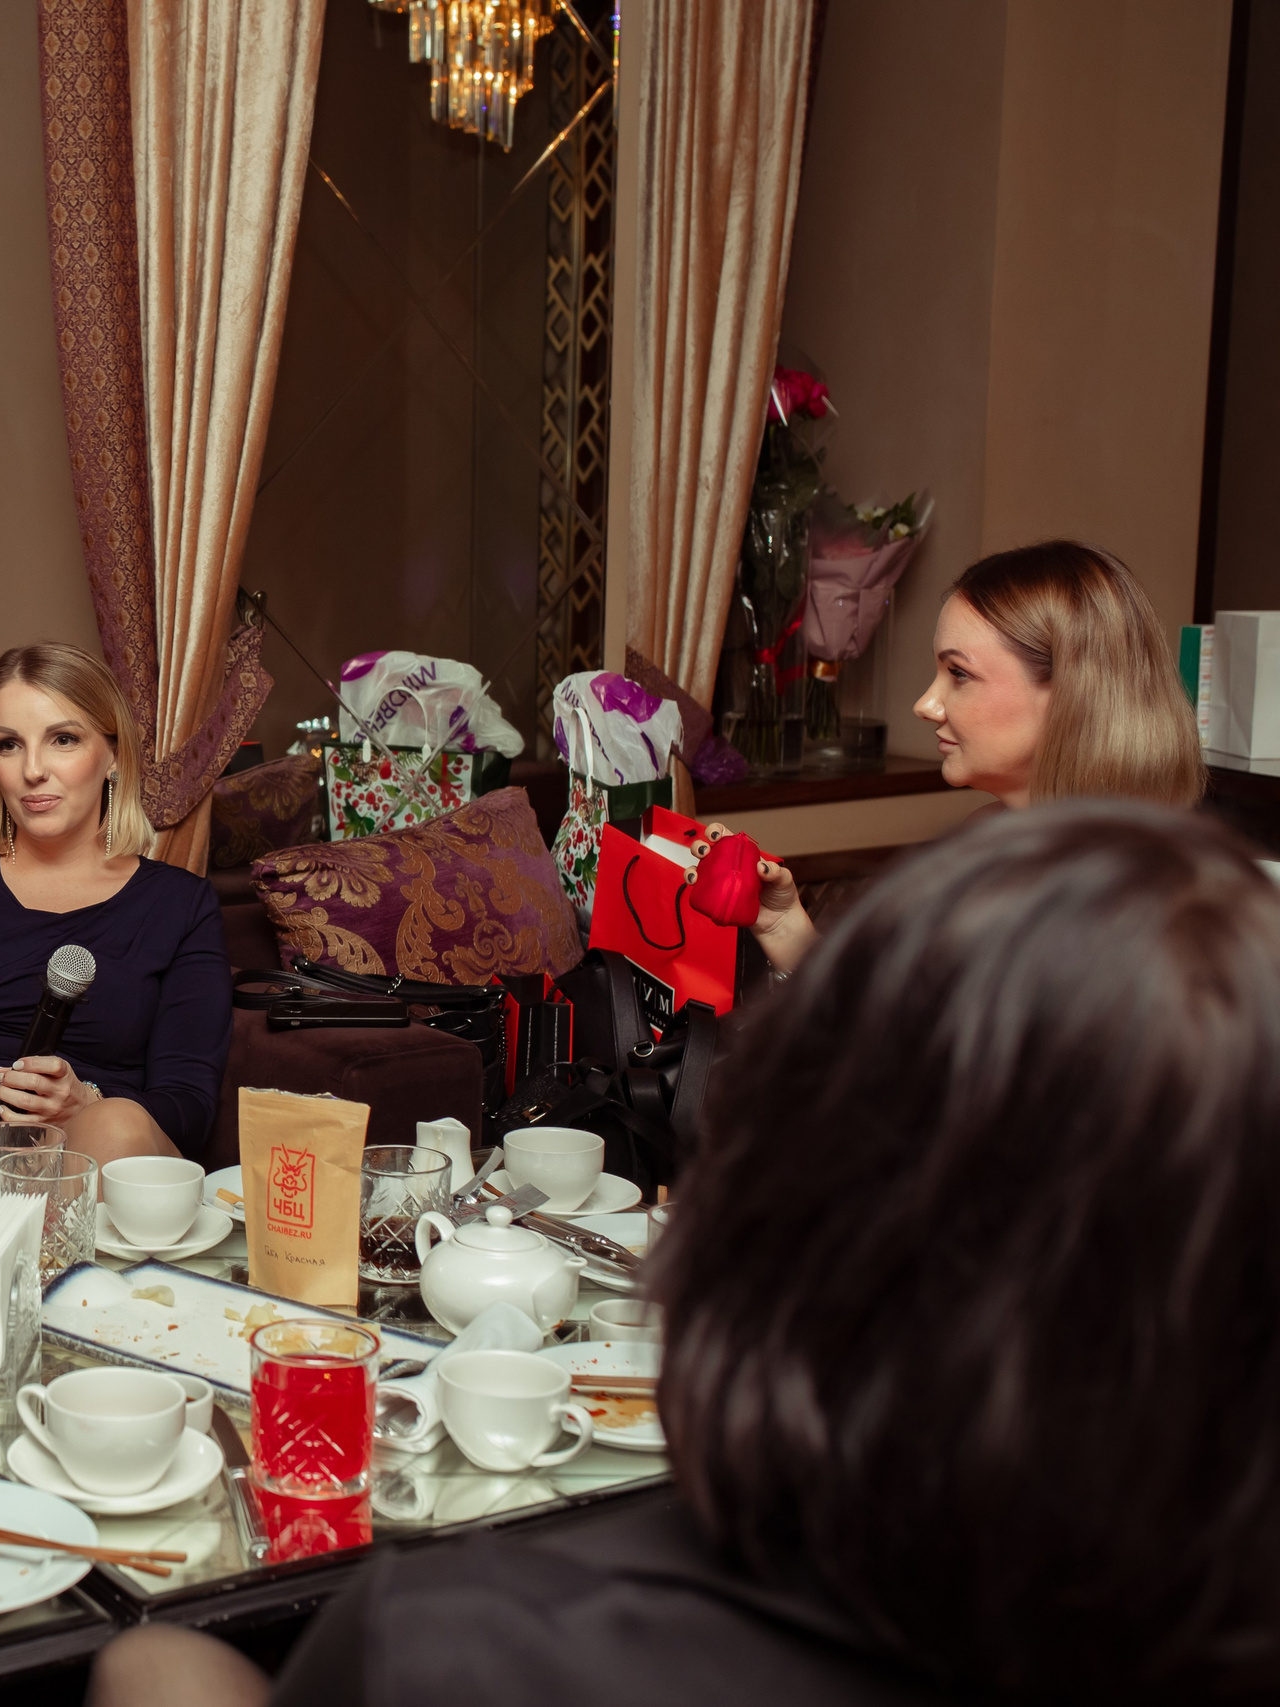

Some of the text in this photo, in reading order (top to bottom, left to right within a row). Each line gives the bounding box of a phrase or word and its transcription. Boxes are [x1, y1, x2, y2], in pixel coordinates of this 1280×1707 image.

[633, 976, 670, 1016] УМ
[273, 1197, 305, 1221] ЧБЦ
[267, 1223, 312, 1239] CHAIBEZ.RU
